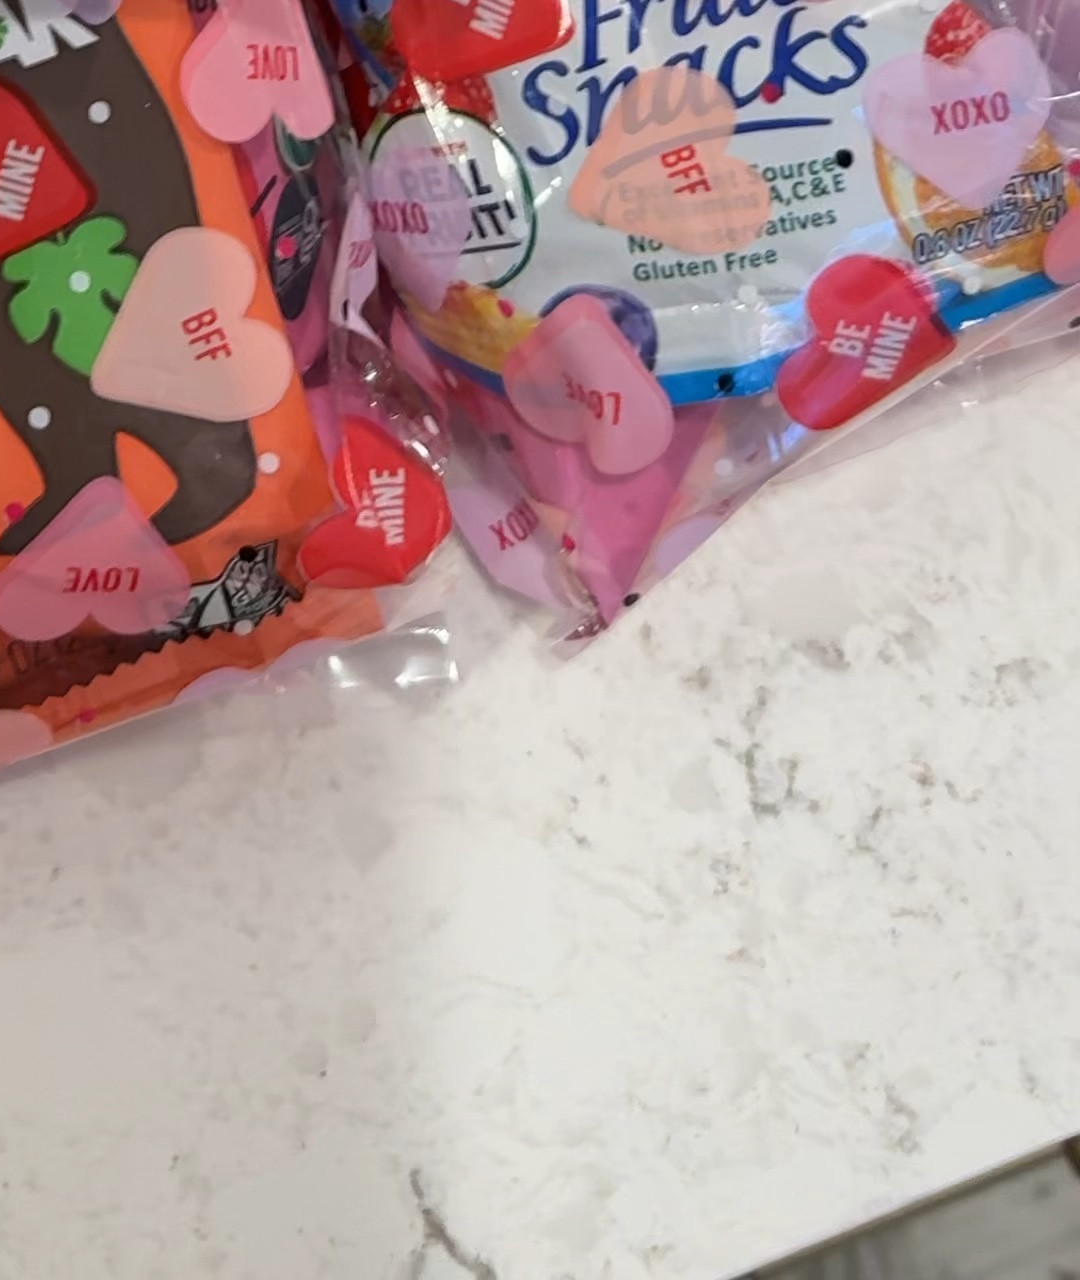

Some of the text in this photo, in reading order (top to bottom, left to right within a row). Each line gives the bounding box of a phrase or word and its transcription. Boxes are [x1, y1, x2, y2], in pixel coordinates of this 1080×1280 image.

[246, 43, 300, 82] LOVE
[523, 7, 868, 167] Snacks
[931, 91, 1010, 135] XOXO
[661, 145, 711, 196] BFF
[372, 201, 429, 235] XOXO
[632, 246, 778, 283] Gluten Free
[180, 307, 233, 363] BFF
[828, 319, 872, 359] BE
[862, 311, 918, 383] MINE
[371, 466, 407, 548] MINE
[61, 566, 142, 595] LOVE
